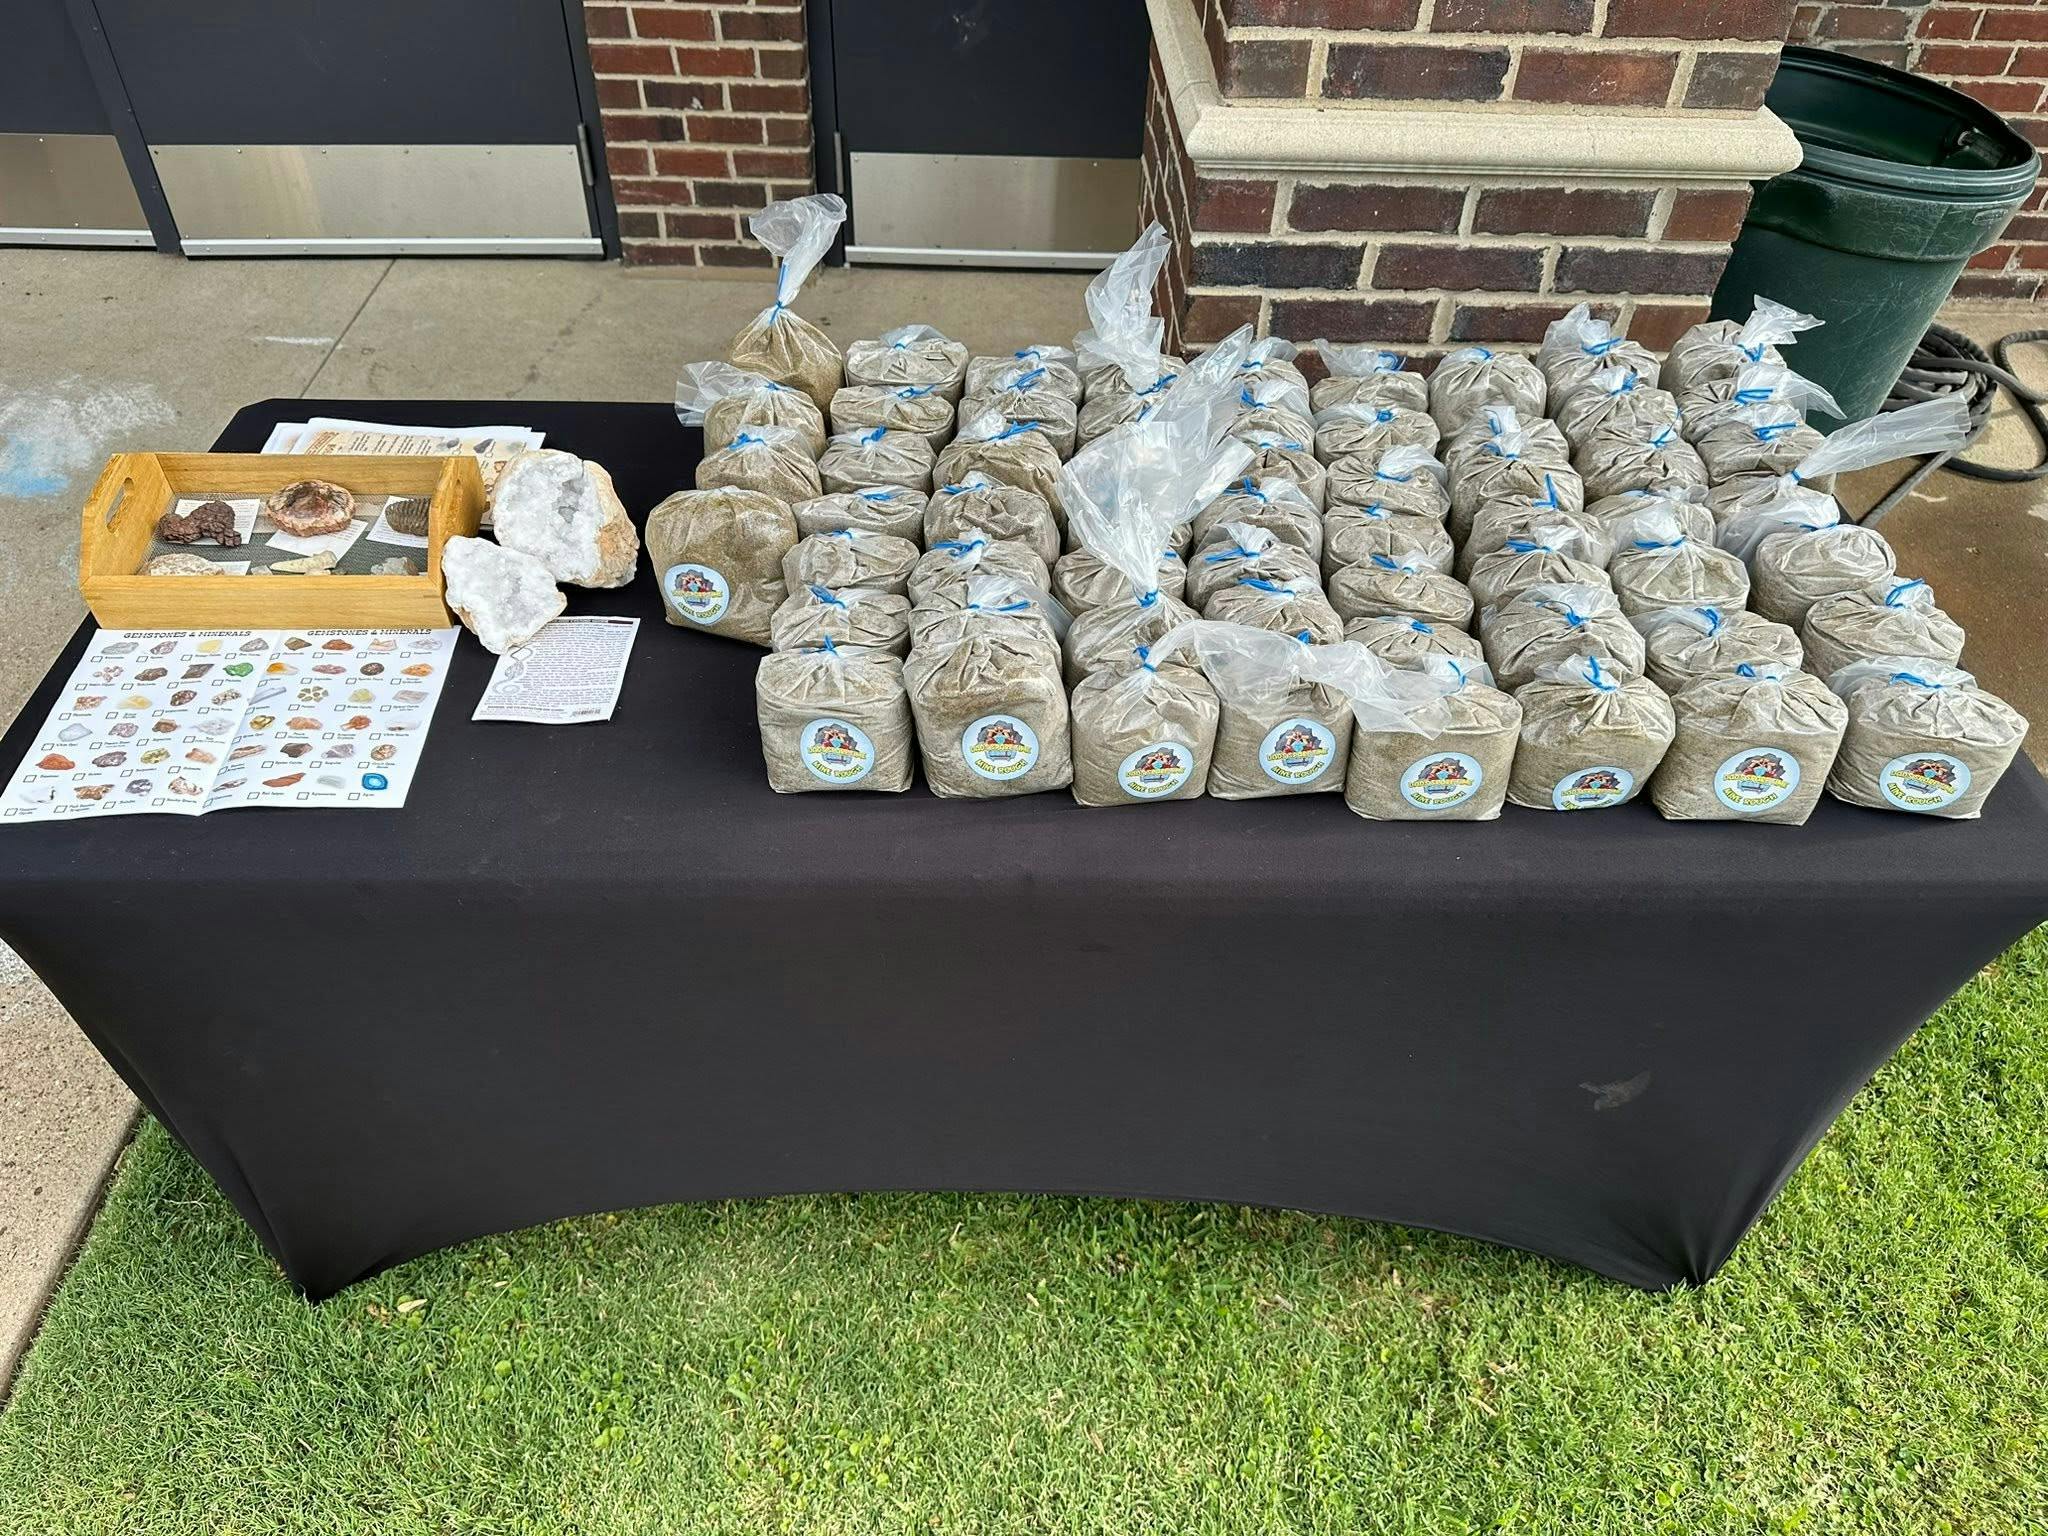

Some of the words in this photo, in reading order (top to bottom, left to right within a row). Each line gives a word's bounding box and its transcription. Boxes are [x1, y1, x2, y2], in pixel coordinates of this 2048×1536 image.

[123, 631, 187, 639] GEMSTONES
[811, 760, 833, 776] MINE
[833, 764, 864, 778] ROUGH
[975, 758, 996, 773] MINE
[997, 758, 1028, 774] ROUGH
[1271, 765, 1293, 778] MINE
[1294, 760, 1325, 778] ROUGH
[1127, 781, 1147, 792] MINE
[1887, 782, 1906, 800] MINE
[1904, 795, 1943, 805] ROUGH
[1411, 792, 1432, 805] MINE
[1723, 787, 1743, 804] MINE
[1742, 792, 1778, 806] ROUGH
